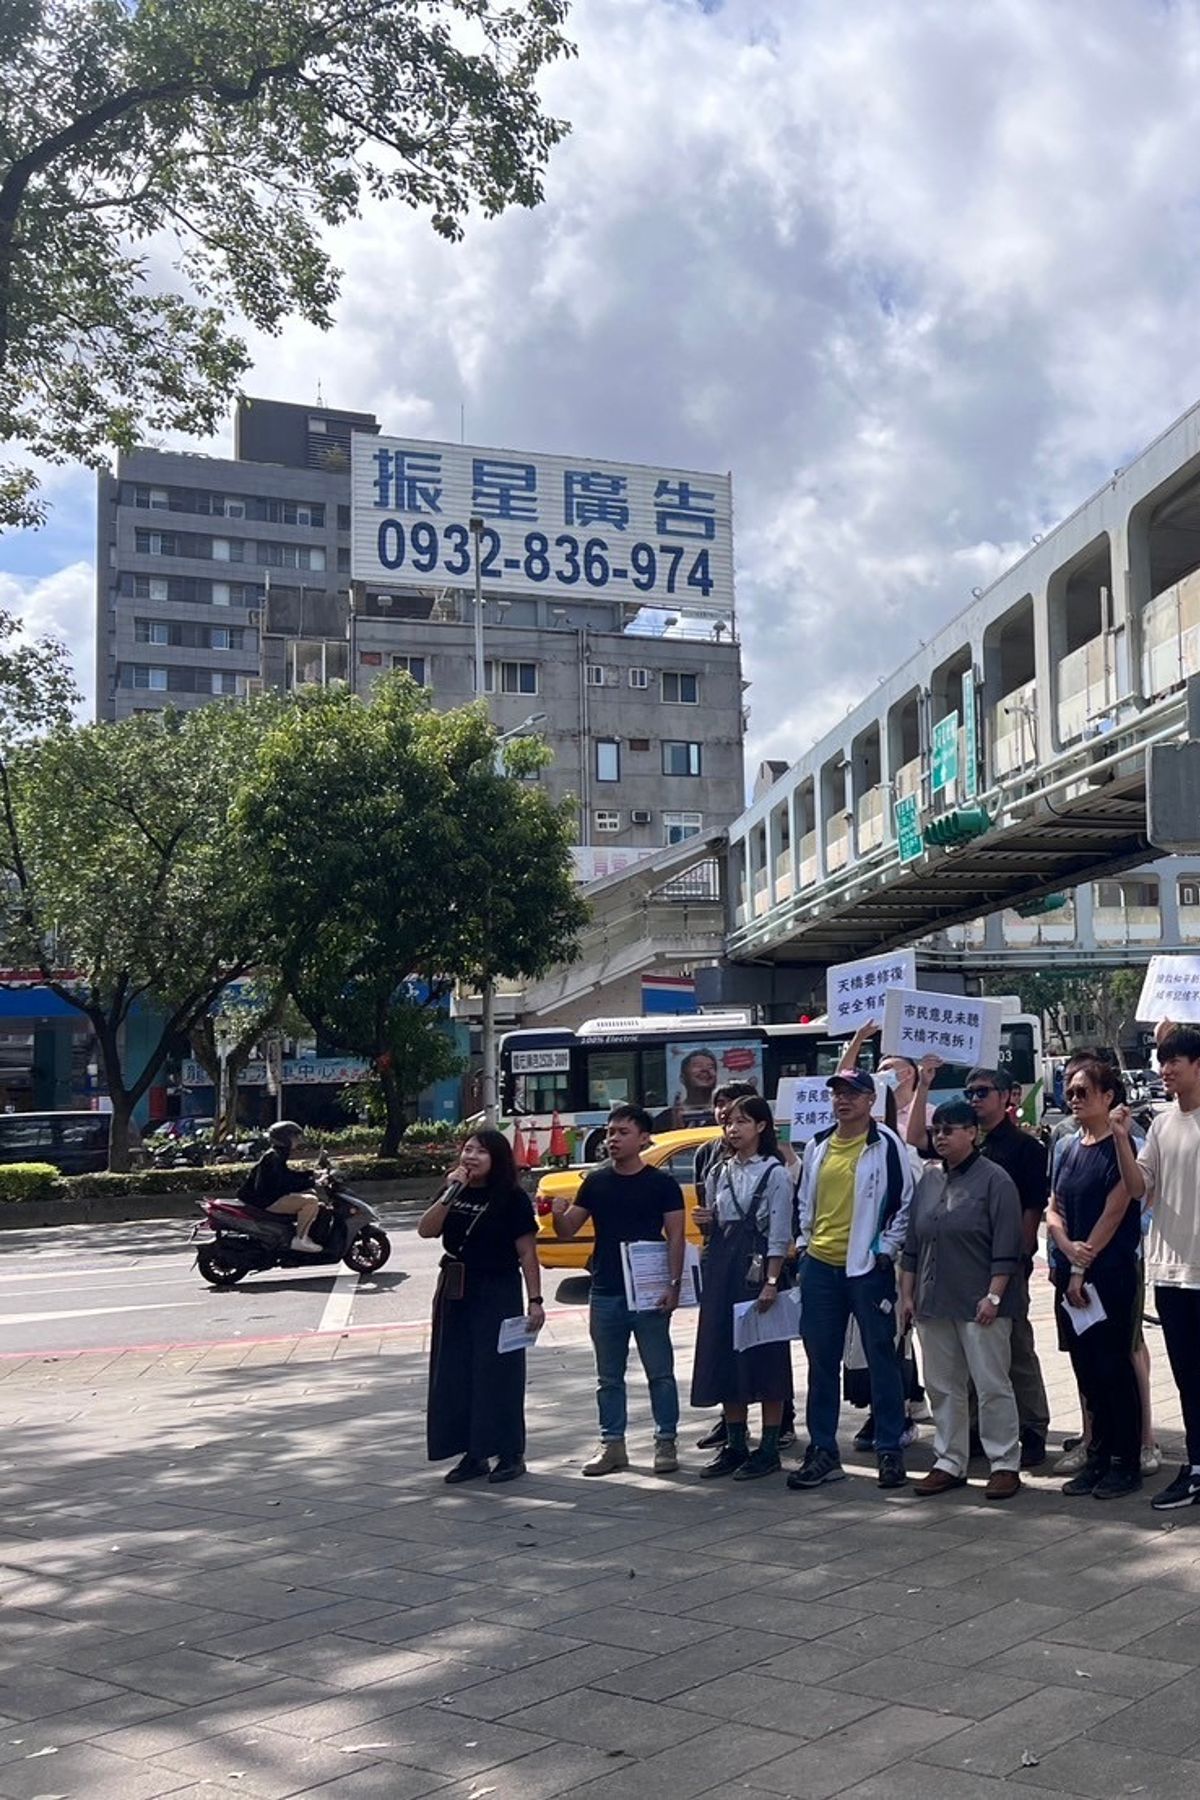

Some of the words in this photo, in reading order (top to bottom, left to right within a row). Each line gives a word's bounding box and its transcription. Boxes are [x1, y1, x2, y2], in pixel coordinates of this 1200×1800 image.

[373, 448, 716, 541] 振星廣告
[377, 518, 714, 597] 0932-836-974
[837, 966, 904, 994] 天橋要修復
[904, 1004, 980, 1028] 市民意見未聽
